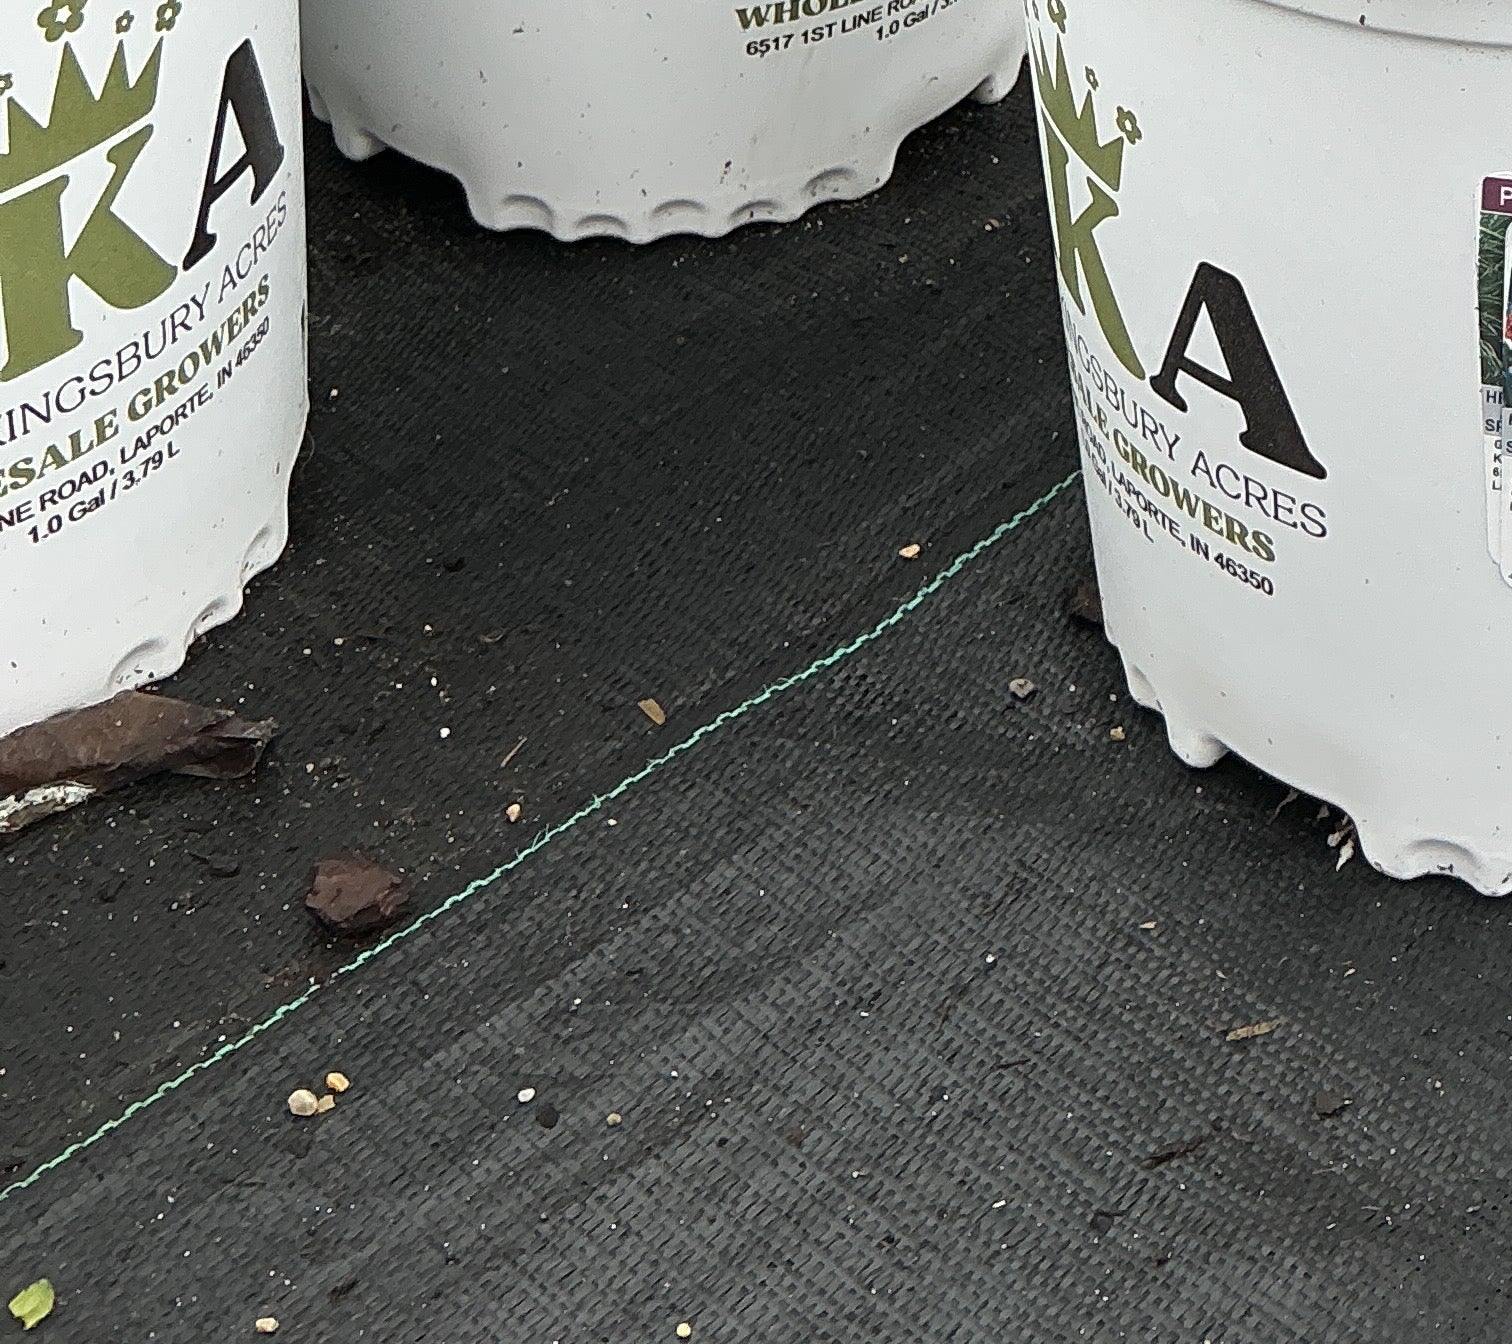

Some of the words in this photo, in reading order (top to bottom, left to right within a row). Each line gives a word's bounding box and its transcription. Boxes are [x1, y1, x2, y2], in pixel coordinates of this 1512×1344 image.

[746, 33, 794, 58] 6517
[801, 22, 838, 45] 1ST
[841, 6, 883, 35] LINE
[876, 21, 900, 42] 1.0
[903, 4, 930, 29] Gal
[0, 38, 285, 383] KA
[0, 281, 212, 446] INGSBURY
[218, 191, 287, 304] ACRES
[127, 273, 270, 423] GROWERS
[1042, 109, 1327, 480] KA
[28, 514, 63, 544] 1.0
[68, 487, 106, 522] Gal
[122, 449, 164, 490] 3.79
[168, 440, 181, 458] L
[39, 460, 115, 512] ROAD,
[120, 383, 214, 464] LAPORTE,
[217, 362, 232, 389] IN
[1113, 428, 1276, 563] GROWERS
[1190, 450, 1328, 539] ACRES
[1111, 461, 1186, 548] LAPORTE,
[1190, 532, 1210, 562] IN
[1213, 552, 1275, 597] 46350
